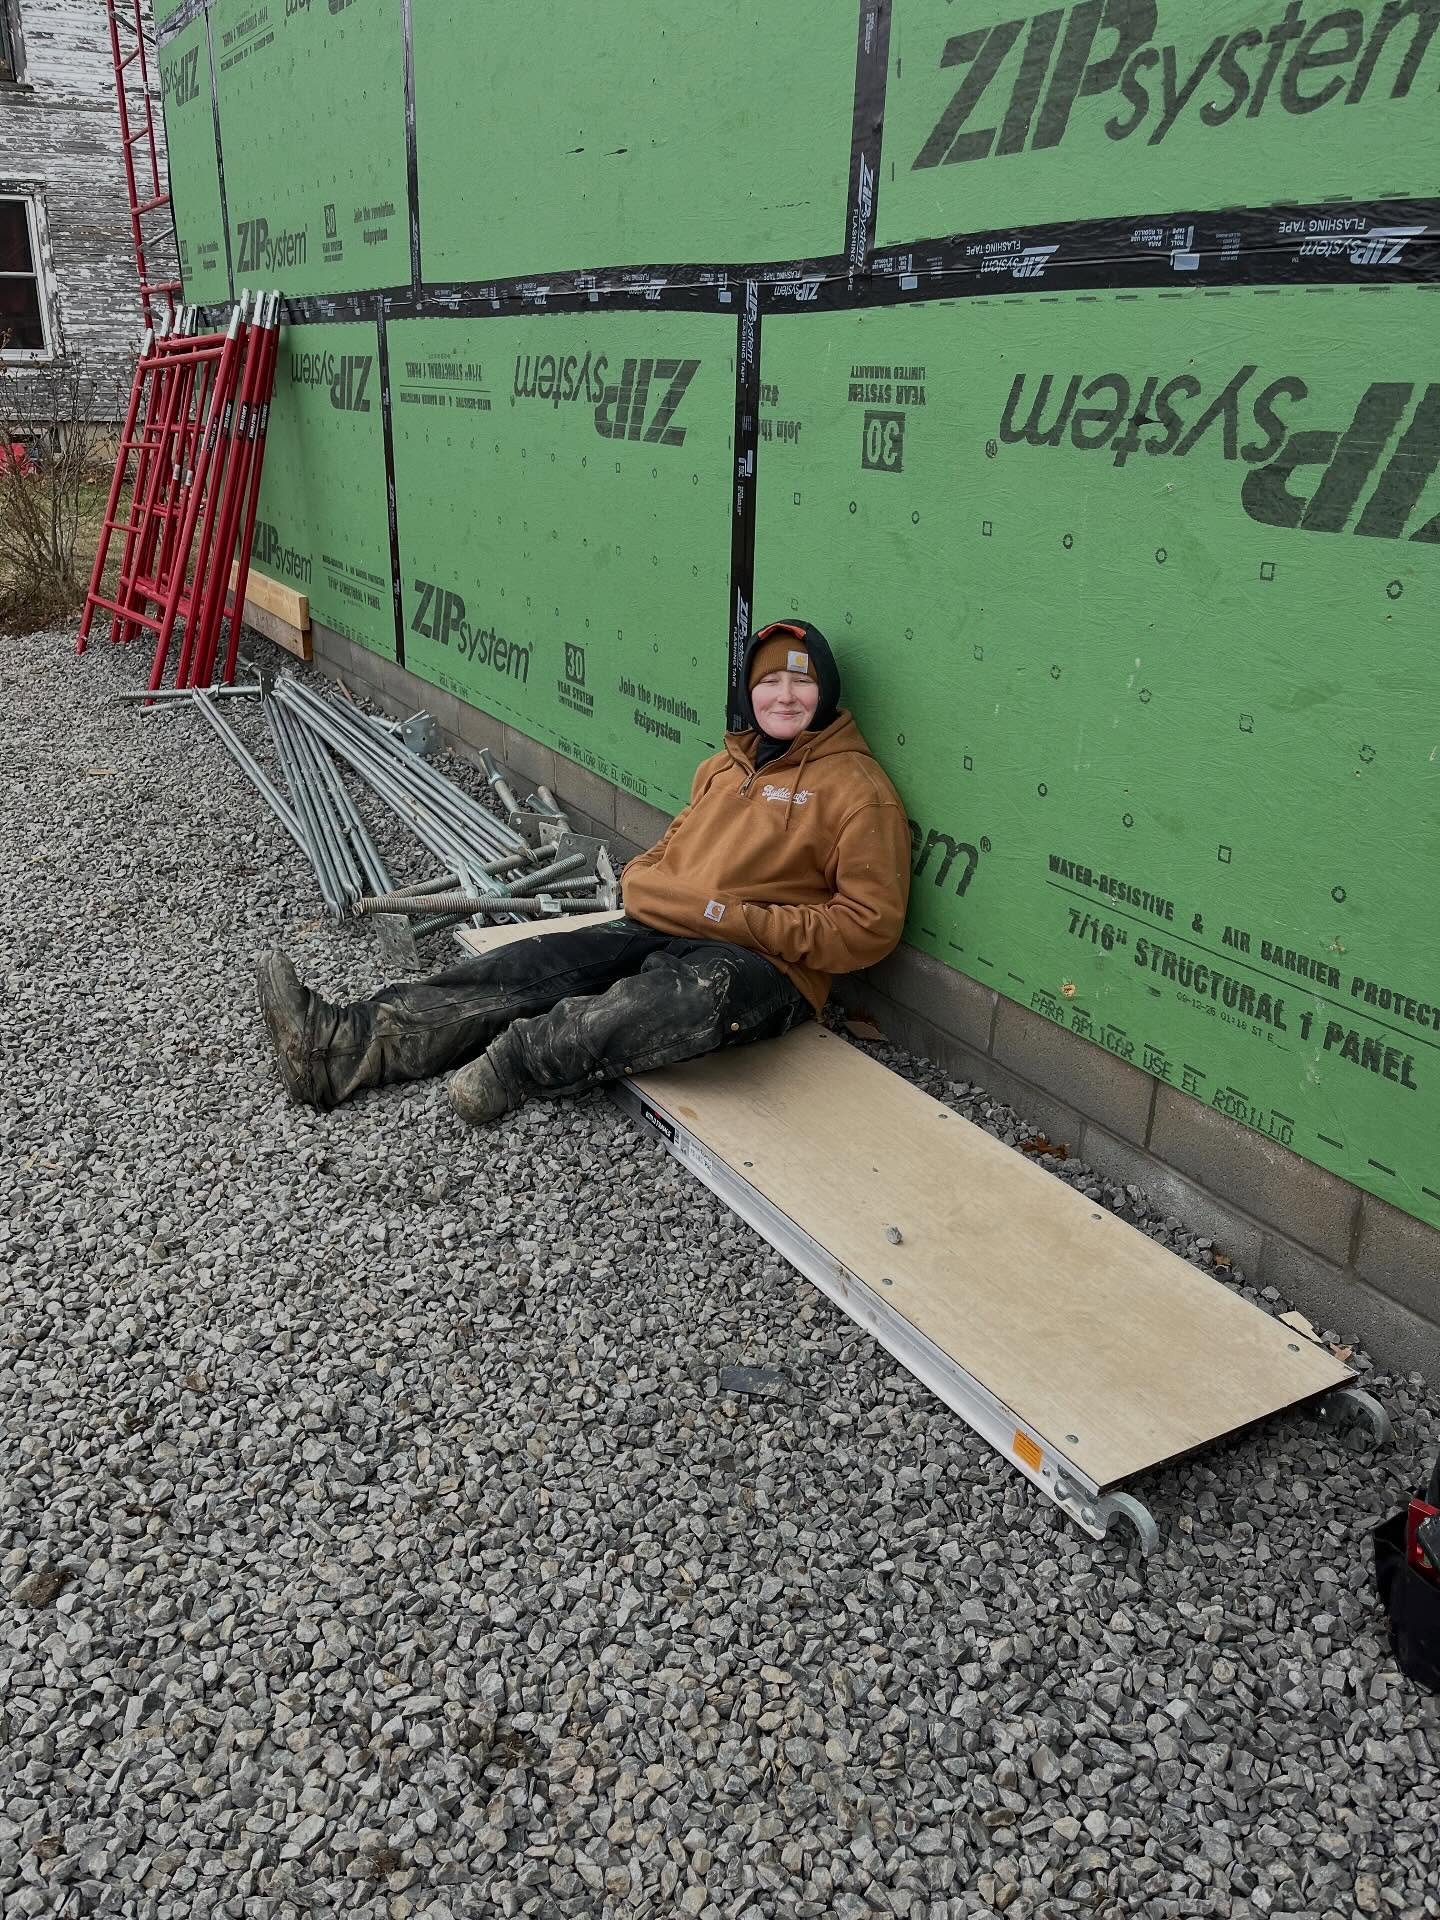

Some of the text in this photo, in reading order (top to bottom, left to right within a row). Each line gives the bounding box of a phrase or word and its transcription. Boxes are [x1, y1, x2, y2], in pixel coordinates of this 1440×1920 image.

[850, 208, 859, 262] FLASHING
[1279, 218, 1367, 233] FLASHING TAPE
[966, 240, 1021, 256] FLASHING TAPE
[850, 365, 926, 381] LIMITED WARRANTY
[848, 384, 927, 406] YEAR SYSTEM
[776, 420, 802, 445] Join
[865, 416, 903, 468] 30
[567, 646, 584, 681] 30
[557, 680, 594, 707] YEAR SYSTEM
[619, 676, 701, 726] Join the revolution.
[633, 707, 682, 744] #zipsystem
[558, 738, 648, 798] PARA APLICAR USE EL RODILLO
[1048, 853, 1175, 922] WATER-RESISTIVE
[1191, 913, 1204, 935] &
[1221, 925, 1251, 954] AIR
[1260, 939, 1341, 990] BARRIER
[1068, 907, 1418, 1091] 7/16" STRUCTURAL 1 PANEL
[1030, 991, 1294, 1147] PARA APLICAR USE EL RODILLO
